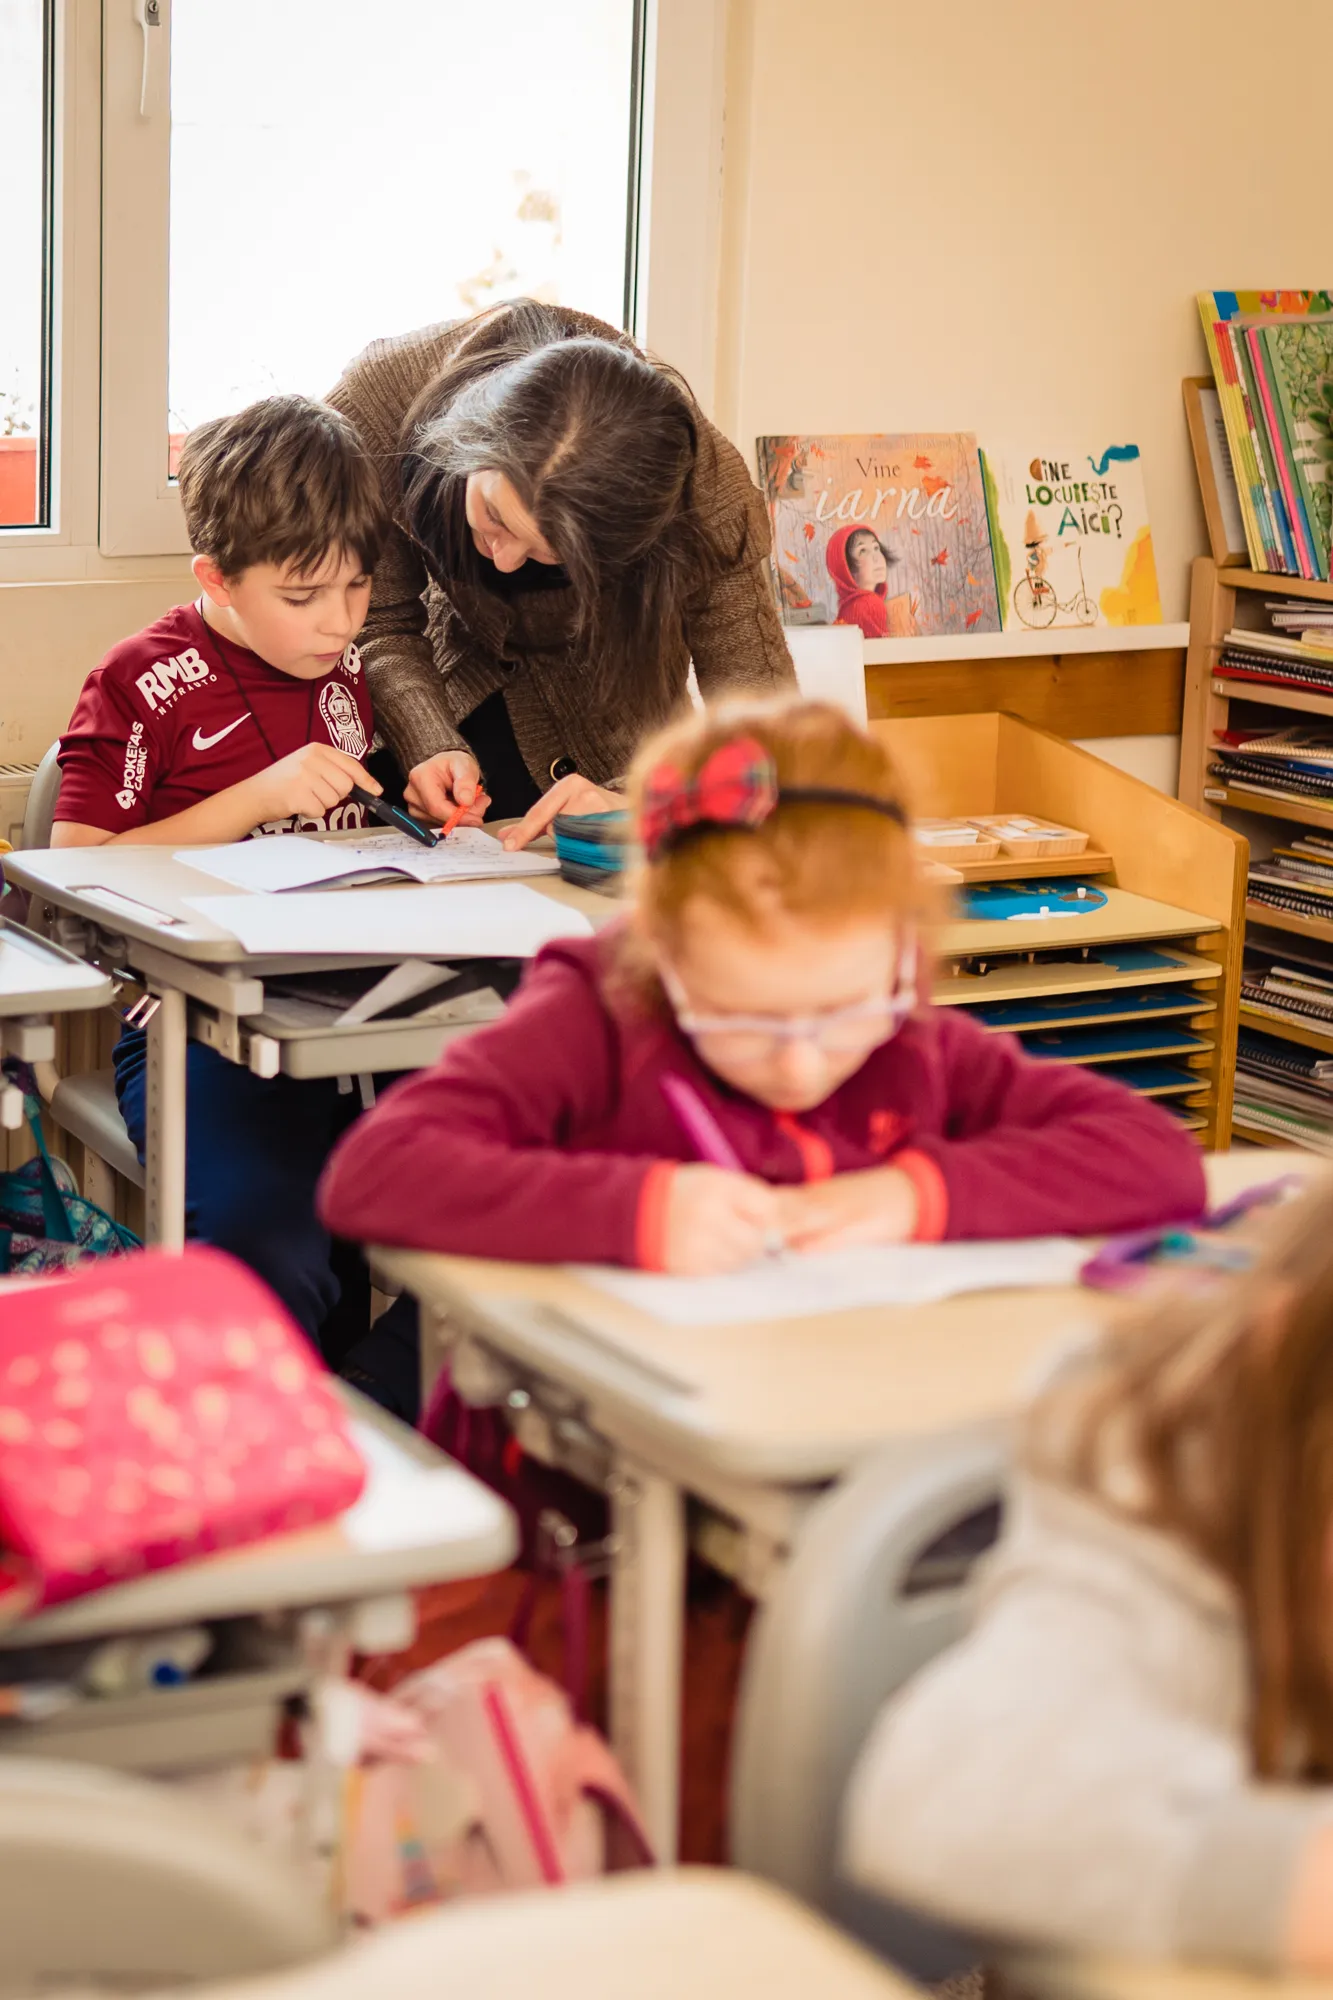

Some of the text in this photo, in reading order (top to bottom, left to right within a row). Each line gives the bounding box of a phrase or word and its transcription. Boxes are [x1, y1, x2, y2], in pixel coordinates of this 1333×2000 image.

[856, 457, 901, 478] Vine
[816, 477, 959, 522] iarna
[134, 647, 210, 711] RMB
[156, 674, 218, 720] NTERAUTO
